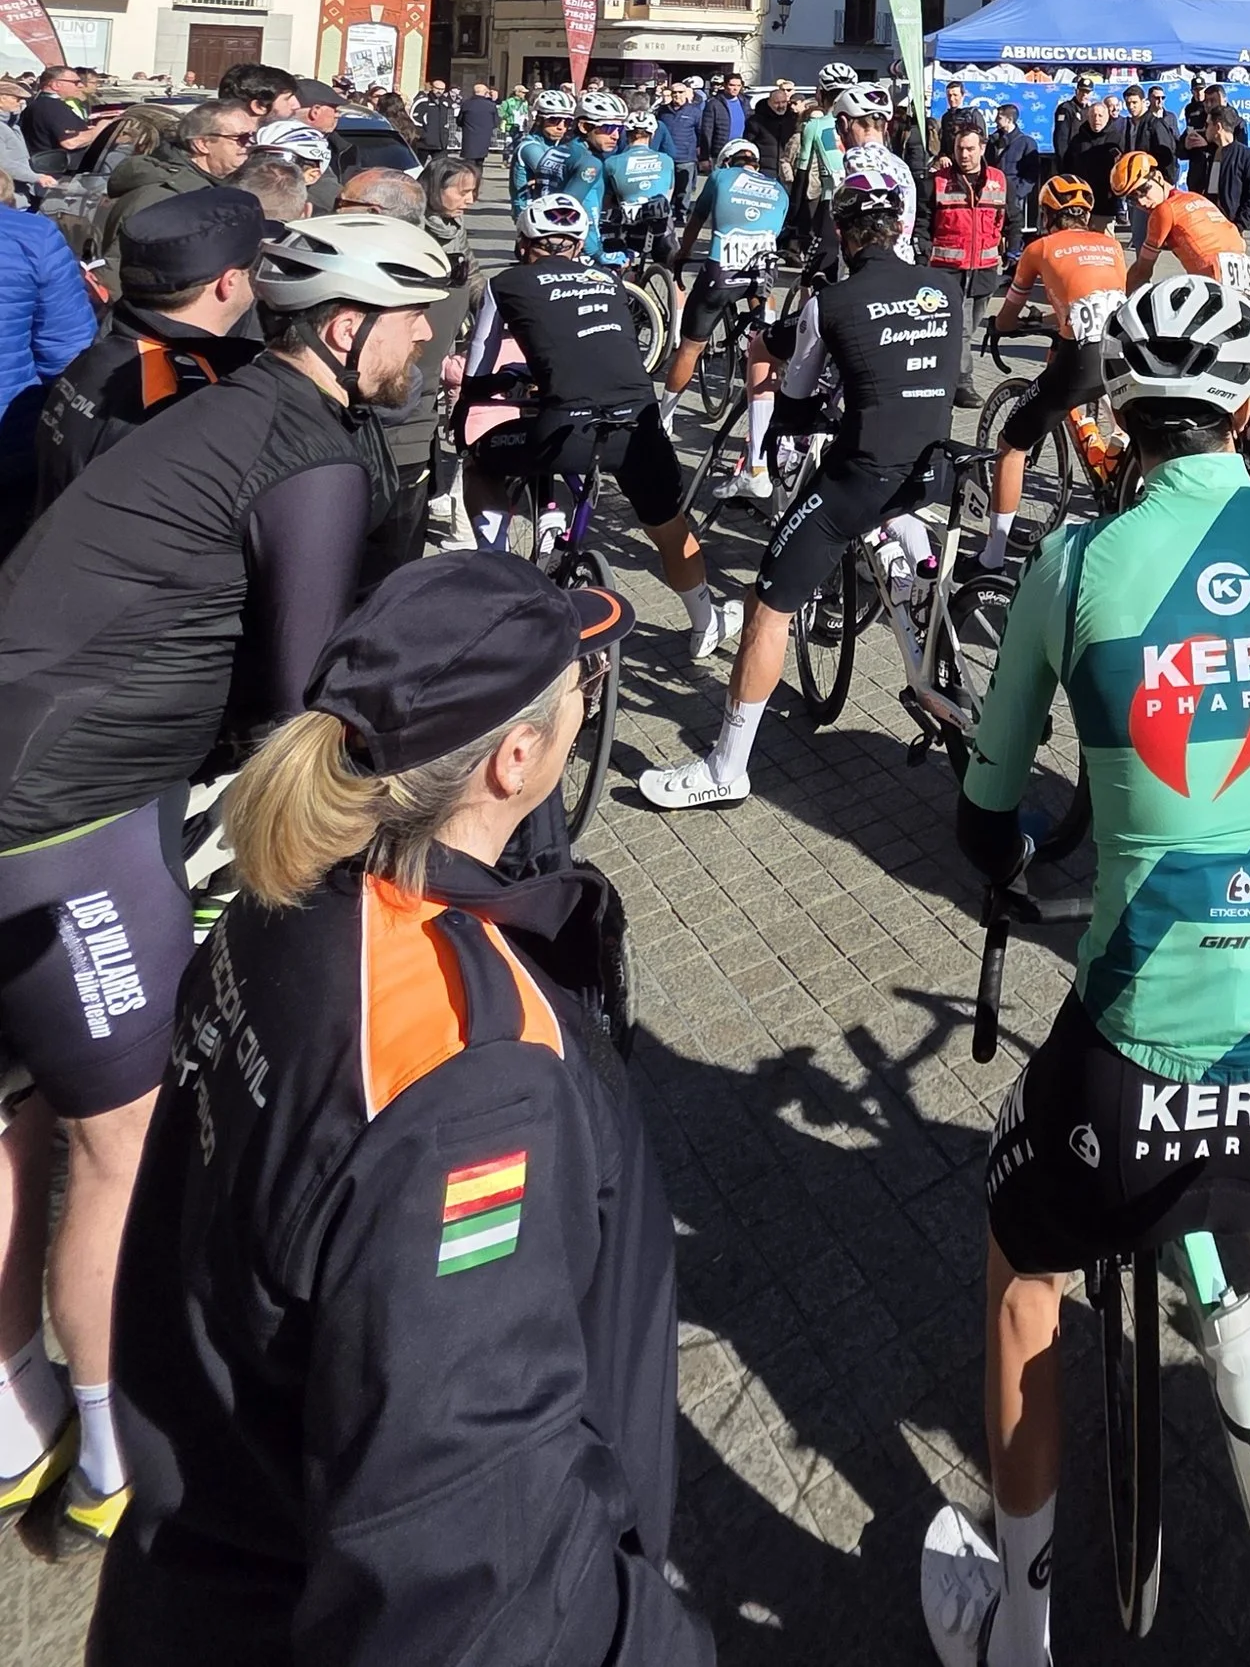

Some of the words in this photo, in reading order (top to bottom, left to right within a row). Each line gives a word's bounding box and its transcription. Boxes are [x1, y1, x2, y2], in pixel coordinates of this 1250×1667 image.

[711, 44, 735, 53] JESUS
[1001, 45, 1153, 63] ABMGCYCLING.ES
[1228, 260, 1240, 286] 97
[577, 303, 609, 316] BH
[1080, 303, 1104, 334] 95
[879, 320, 948, 346] Burpellet
[906, 356, 937, 371] BH
[1206, 386, 1238, 401] GIANT
[968, 494, 986, 521] 67
[771, 493, 823, 558] SIROKO
[687, 785, 731, 804] nimbi
[66, 890, 119, 930] LOS
[84, 924, 147, 1017] VILLARES
[73, 969, 100, 1003] bike
[83, 1002, 112, 1039] team
[236, 1025, 271, 1110] CIVIL
